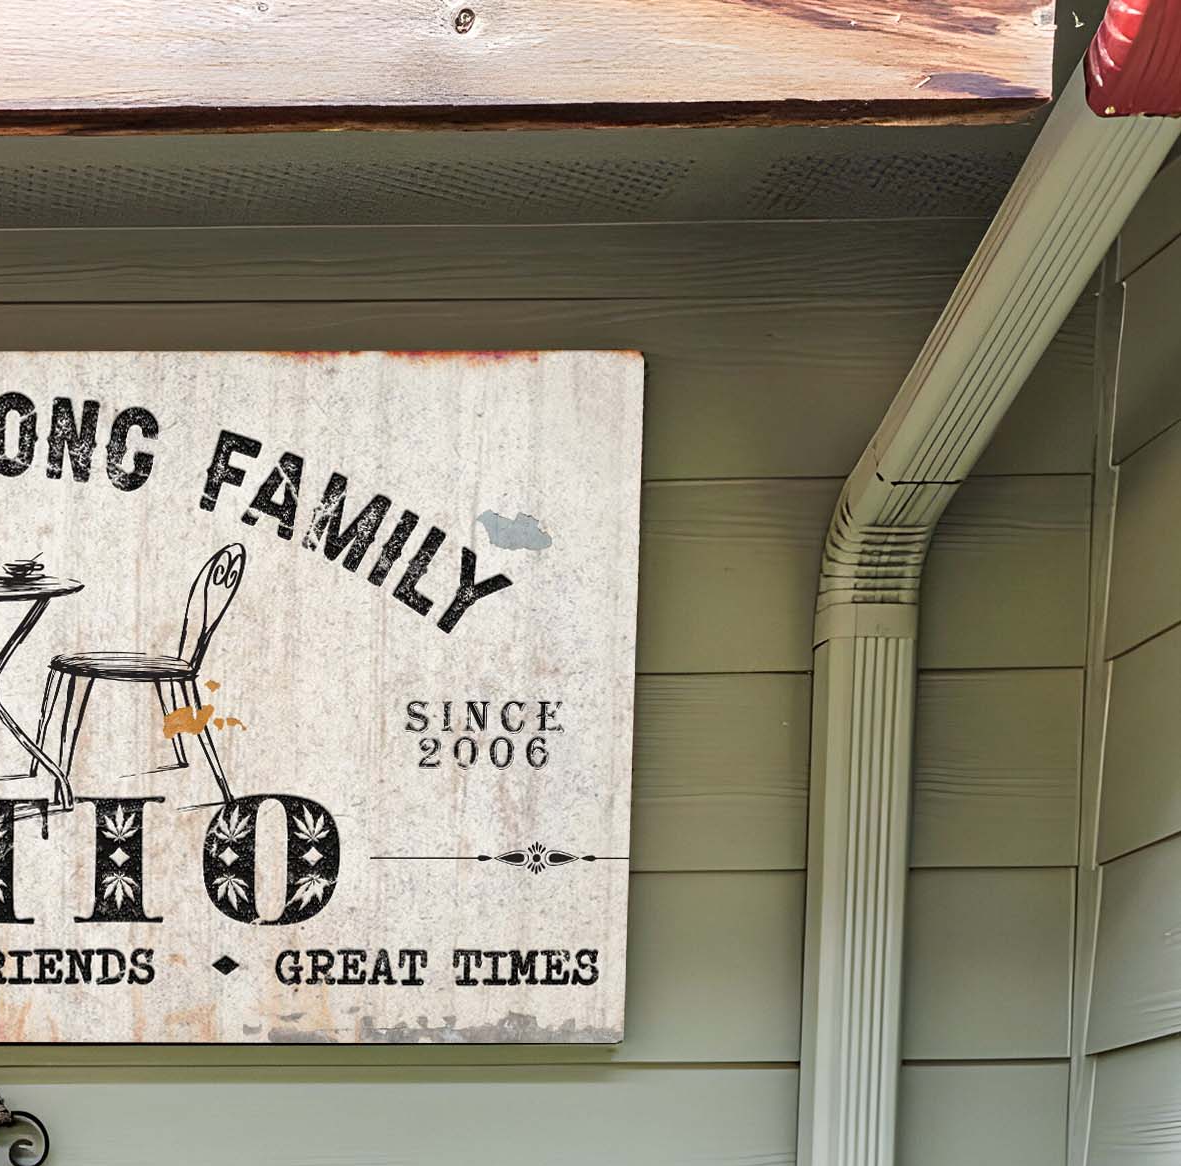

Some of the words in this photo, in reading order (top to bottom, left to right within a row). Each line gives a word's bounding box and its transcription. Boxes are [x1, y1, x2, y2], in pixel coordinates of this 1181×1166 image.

[198, 429, 512, 634] FAMILY
[405, 700, 564, 733] SINCE
[418, 737, 549, 769] 2006
[275, 949, 427, 985] GREAT
[453, 949, 598, 986] TIMES
